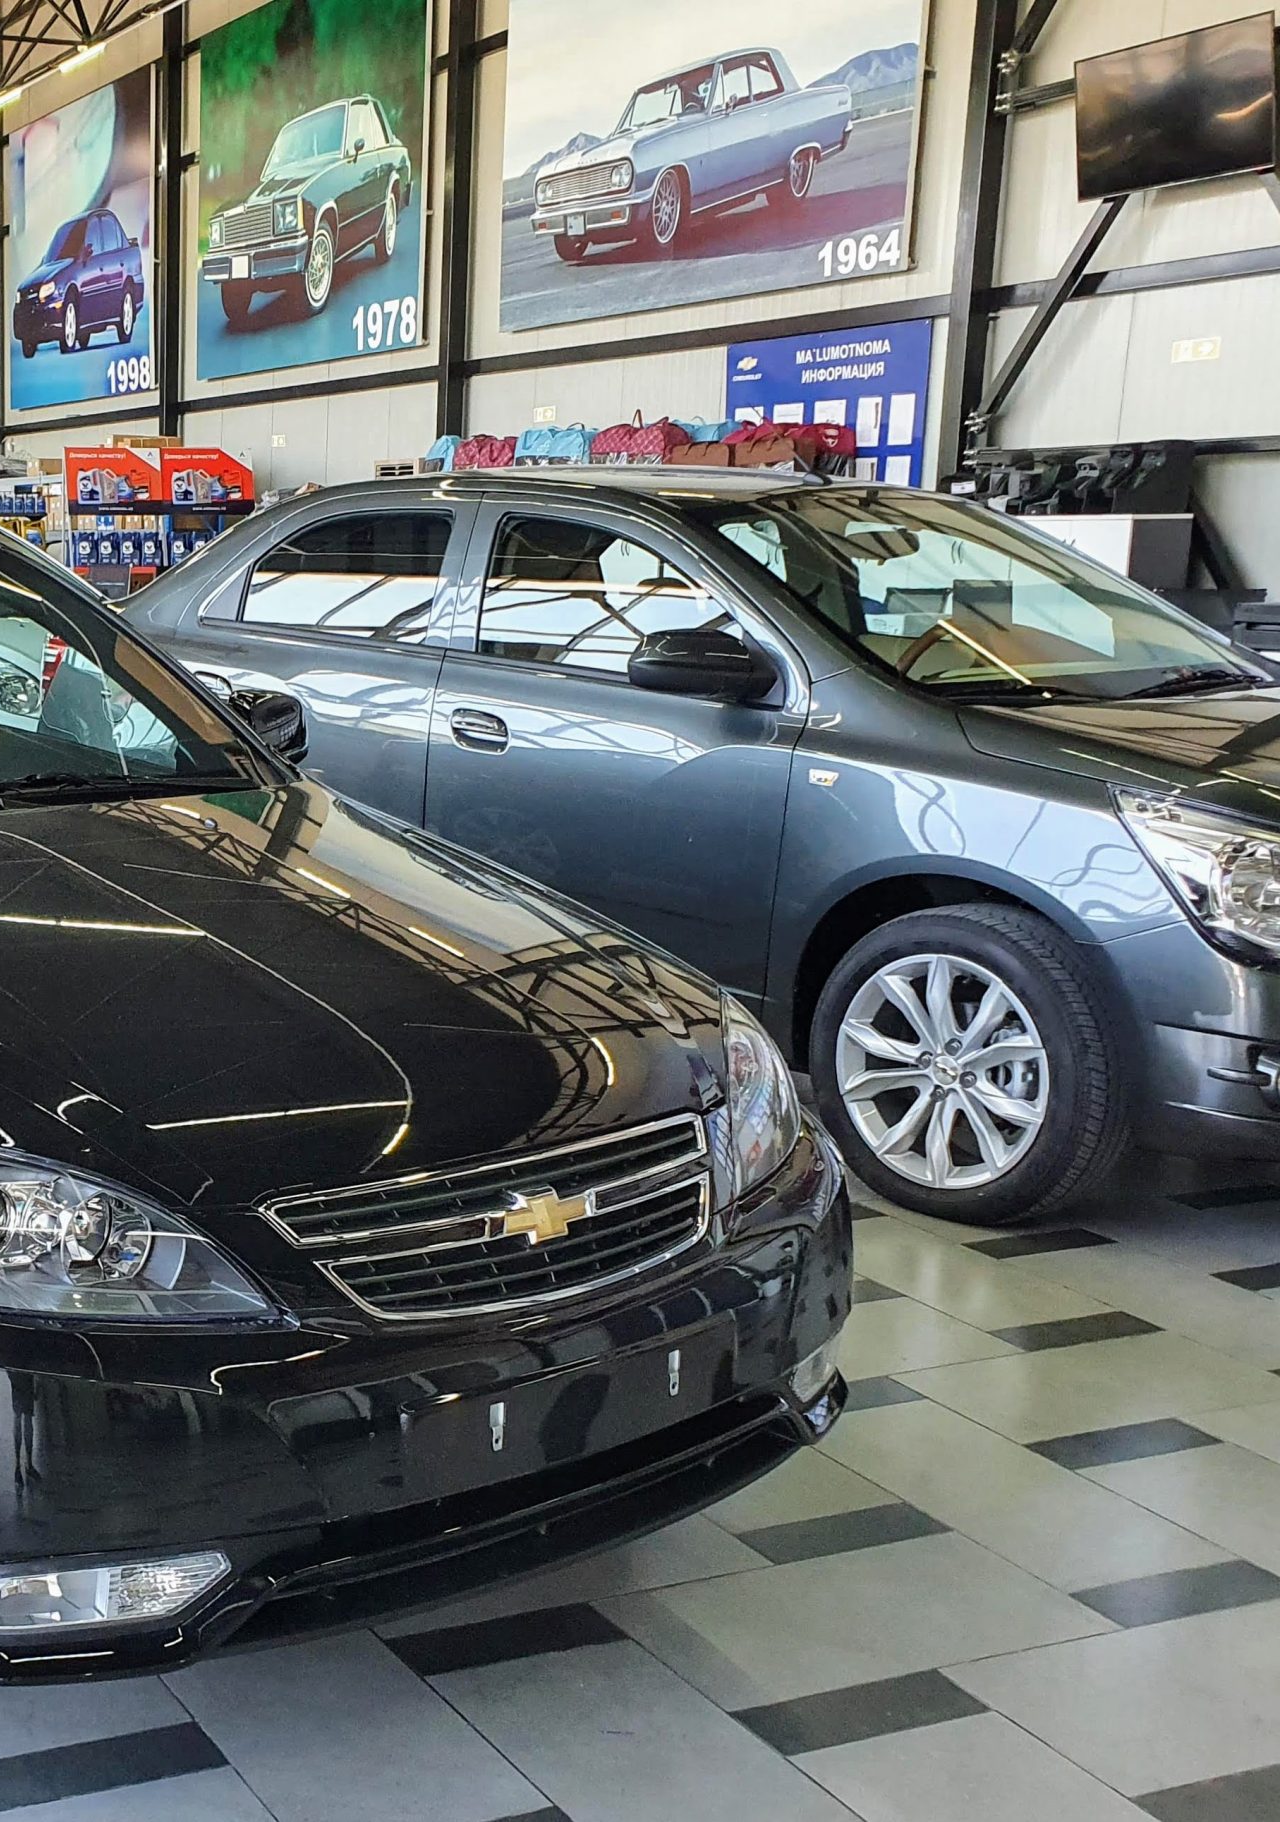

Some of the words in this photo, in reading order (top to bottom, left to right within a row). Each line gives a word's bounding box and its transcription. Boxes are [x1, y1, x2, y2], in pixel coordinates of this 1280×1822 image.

[818, 228, 900, 277] 1964
[352, 296, 416, 351] 1978
[107, 355, 150, 394] 1998
[801, 361, 885, 384] ИНФОРМАЦИЯ
